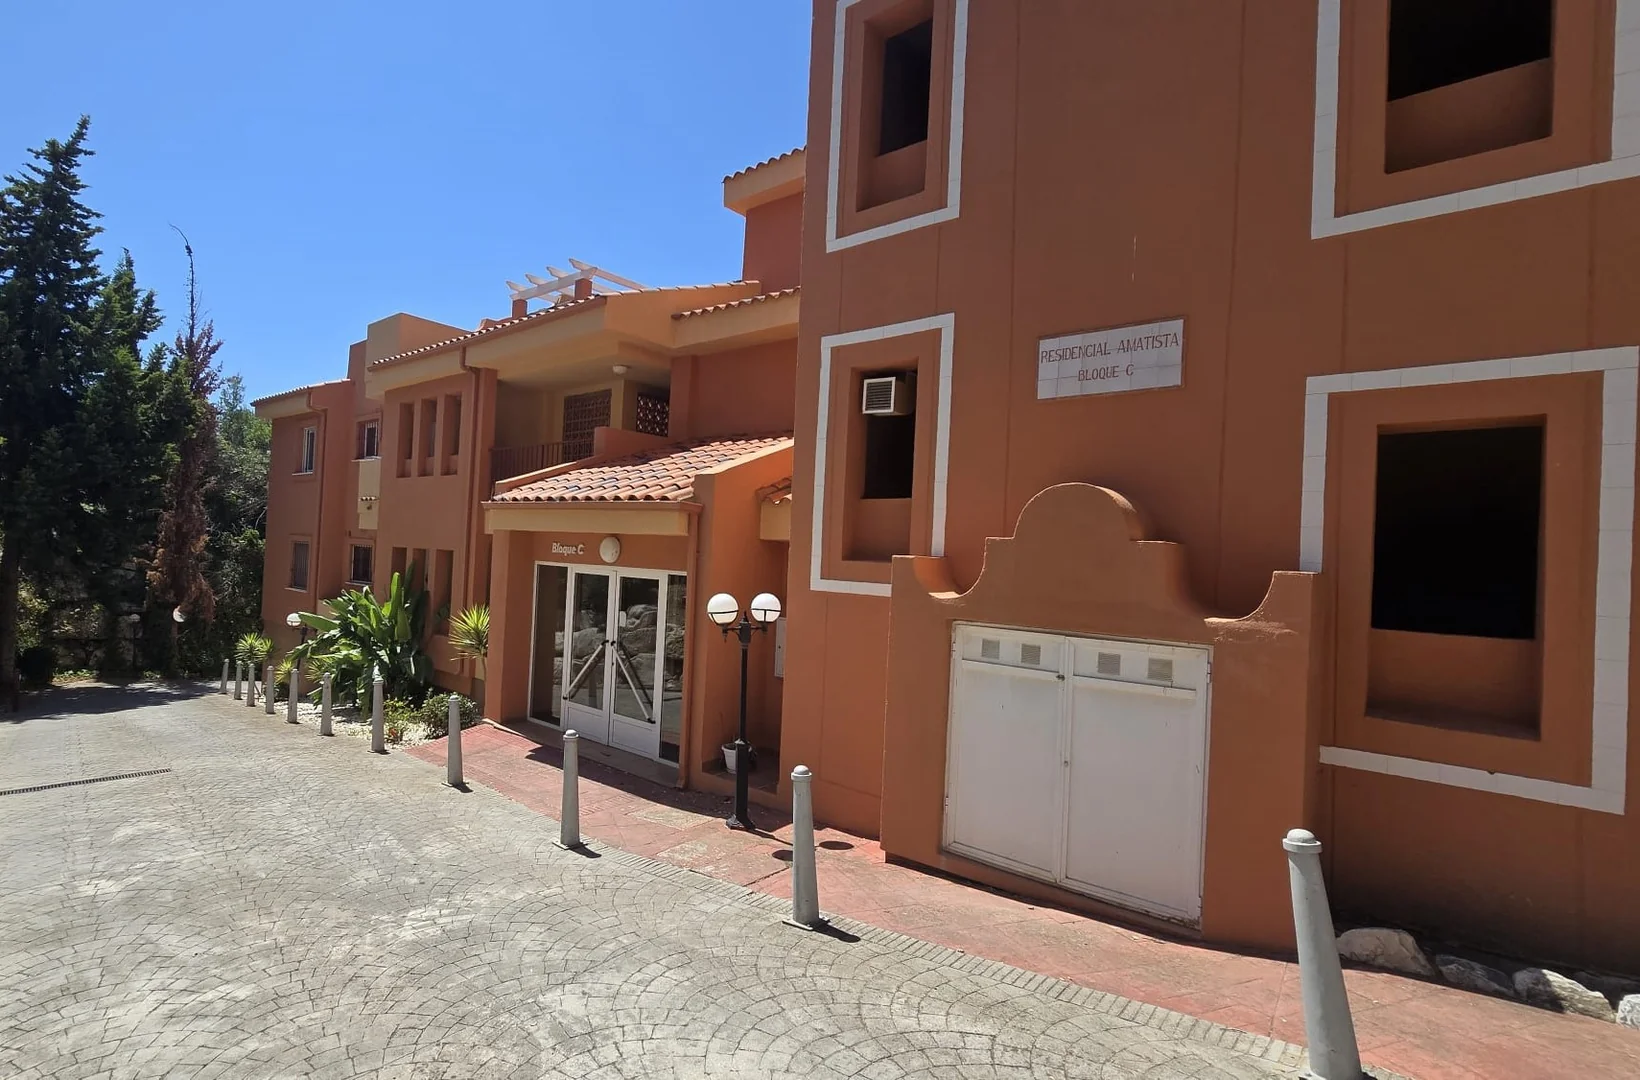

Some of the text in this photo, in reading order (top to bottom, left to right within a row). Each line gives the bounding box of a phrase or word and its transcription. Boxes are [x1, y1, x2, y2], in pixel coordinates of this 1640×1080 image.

[1040, 333, 1179, 363] RESIDENCIAL AMATISTA
[1078, 364, 1134, 381] BLOQUE C
[552, 543, 585, 556] Bloque C
